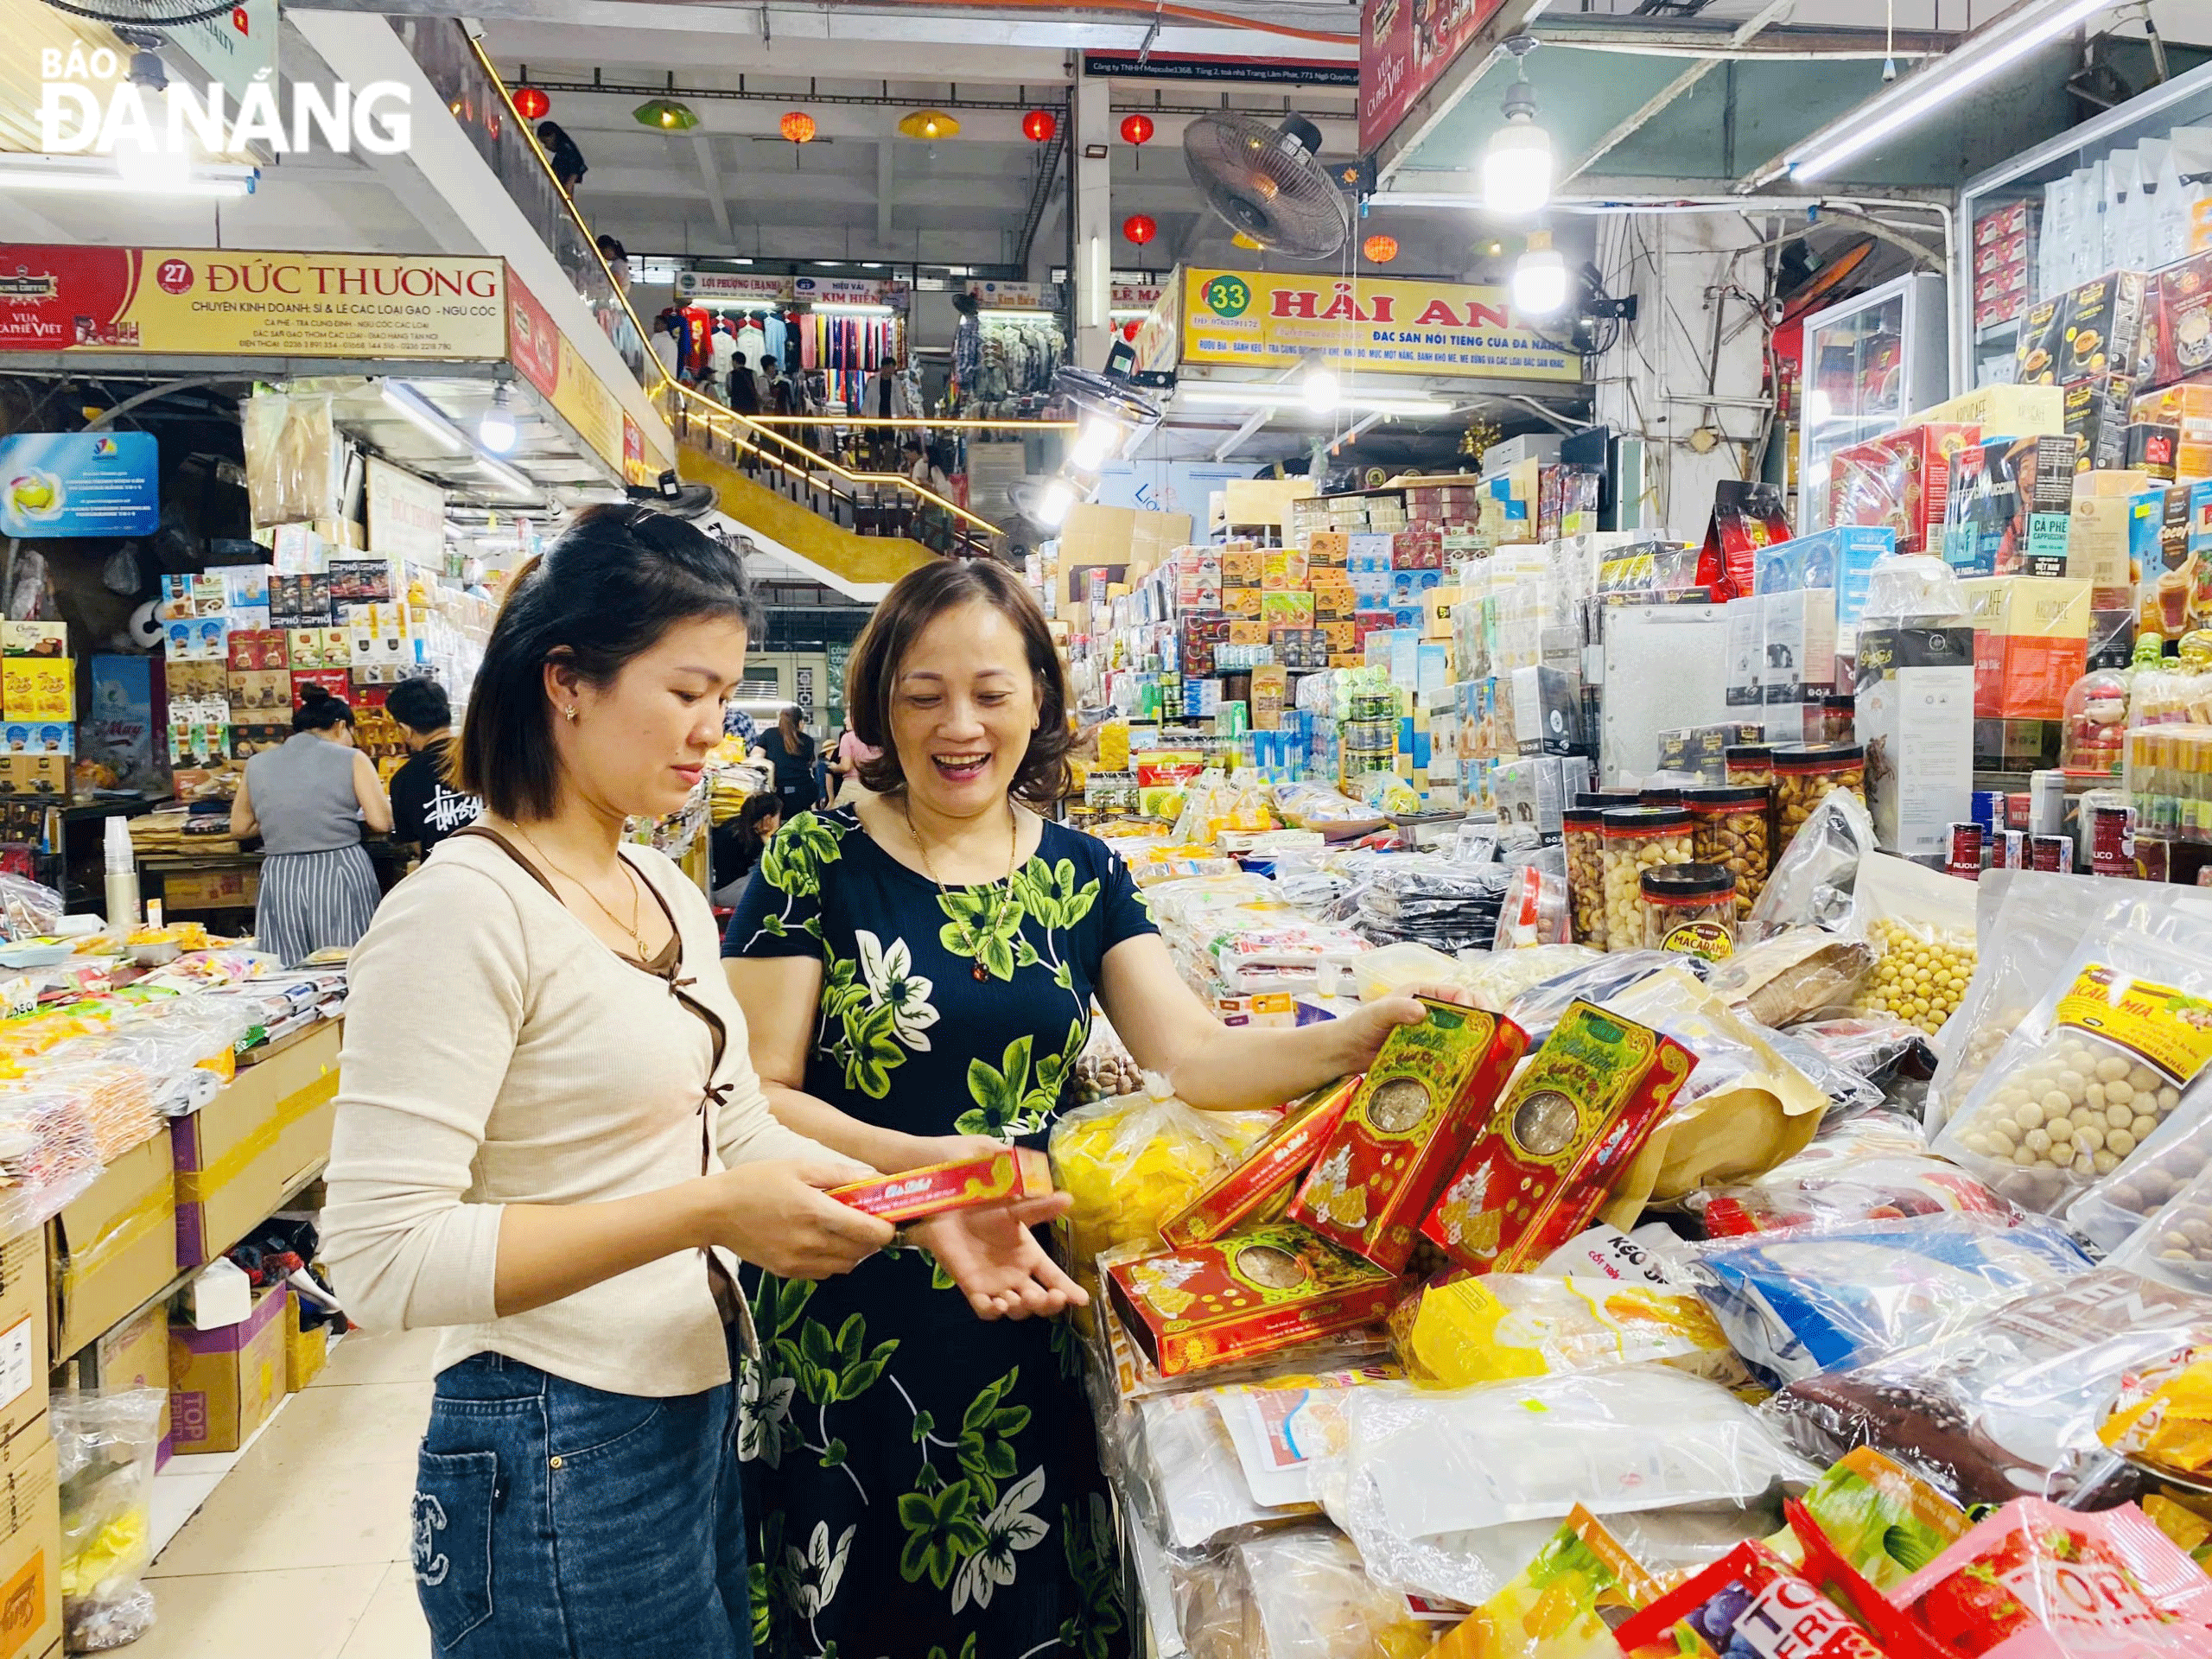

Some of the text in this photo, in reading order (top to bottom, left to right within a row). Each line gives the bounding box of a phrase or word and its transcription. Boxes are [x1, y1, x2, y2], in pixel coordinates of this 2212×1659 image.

[164, 264, 187, 283] 27
[206, 258, 497, 297] ĐỨC THƯƠNG
[823, 293, 846, 303] KIM
[1212, 284, 1244, 309] 33
[1270, 283, 1395, 323] HẢI
[192, 301, 237, 312] CHUYÊN
[239, 302, 265, 313] KINH
[325, 303, 334, 314] &
[470, 304, 496, 316] CỐC
[1373, 331, 1395, 343] ĐẶC
[2033, 518, 2068, 533] CÀ PHÊ
[1674, 934, 1729, 953] MACADAMIA
[1607, 1236, 1648, 1266] KẸO
[184, 1395, 204, 1439] TOP
